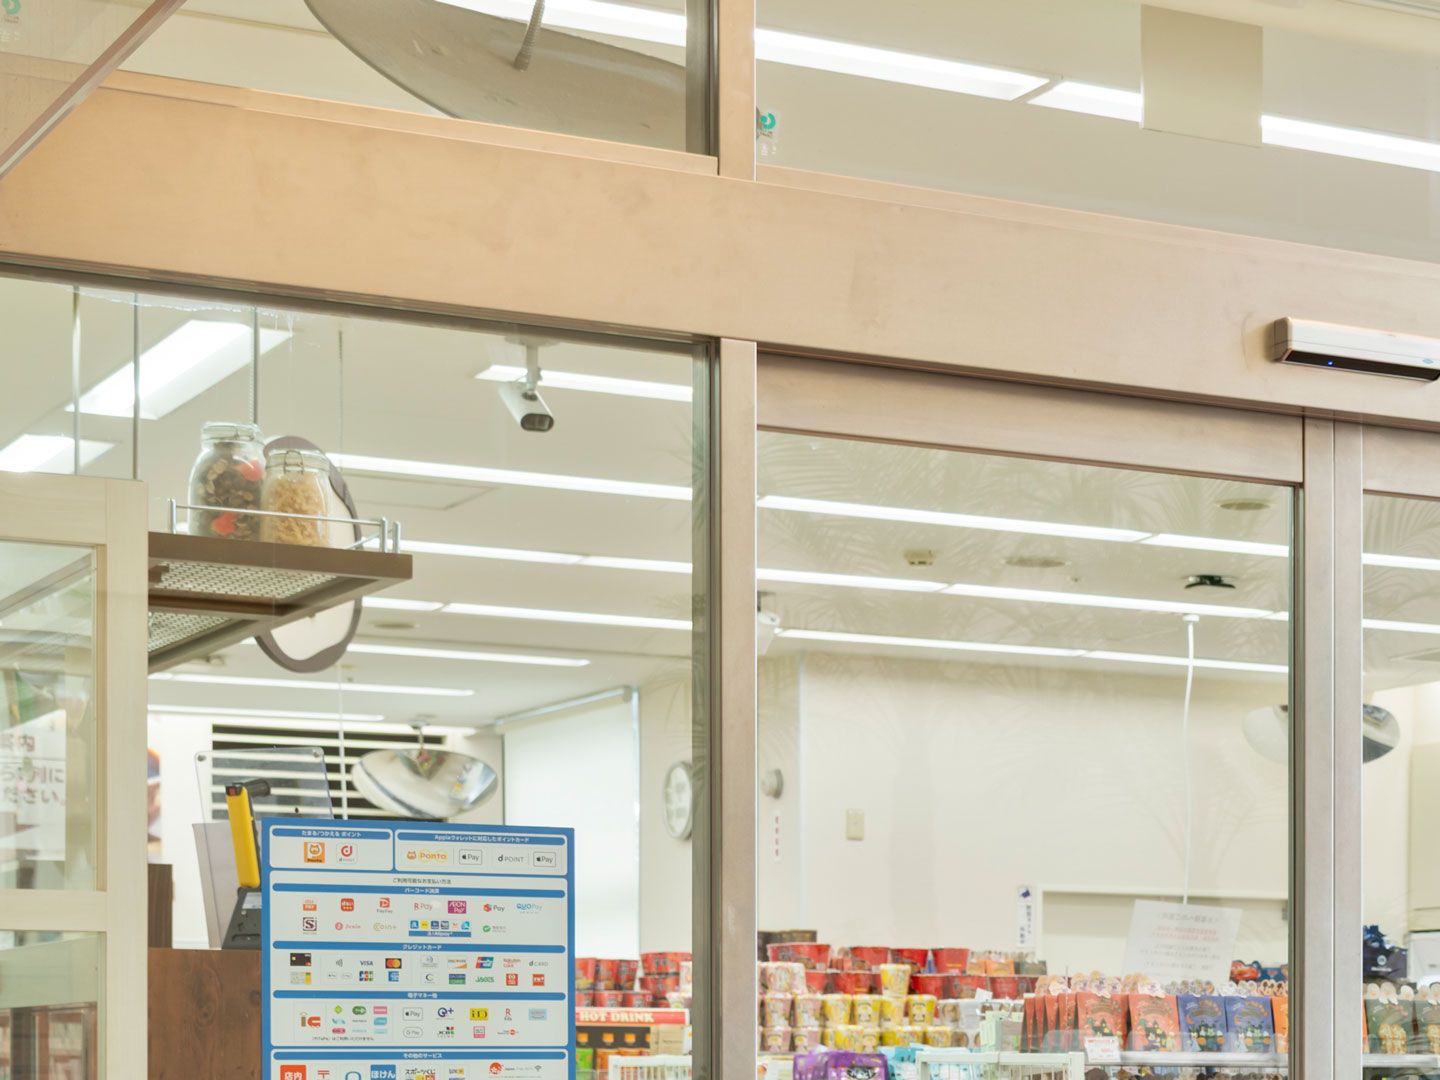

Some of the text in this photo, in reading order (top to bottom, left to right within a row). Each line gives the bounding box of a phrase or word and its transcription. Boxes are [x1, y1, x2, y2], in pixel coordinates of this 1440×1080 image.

[580, 1010, 654, 1023] HOT DRINK
[284, 1071, 302, 1080] 店内
[371, 1070, 396, 1079] ほけん
